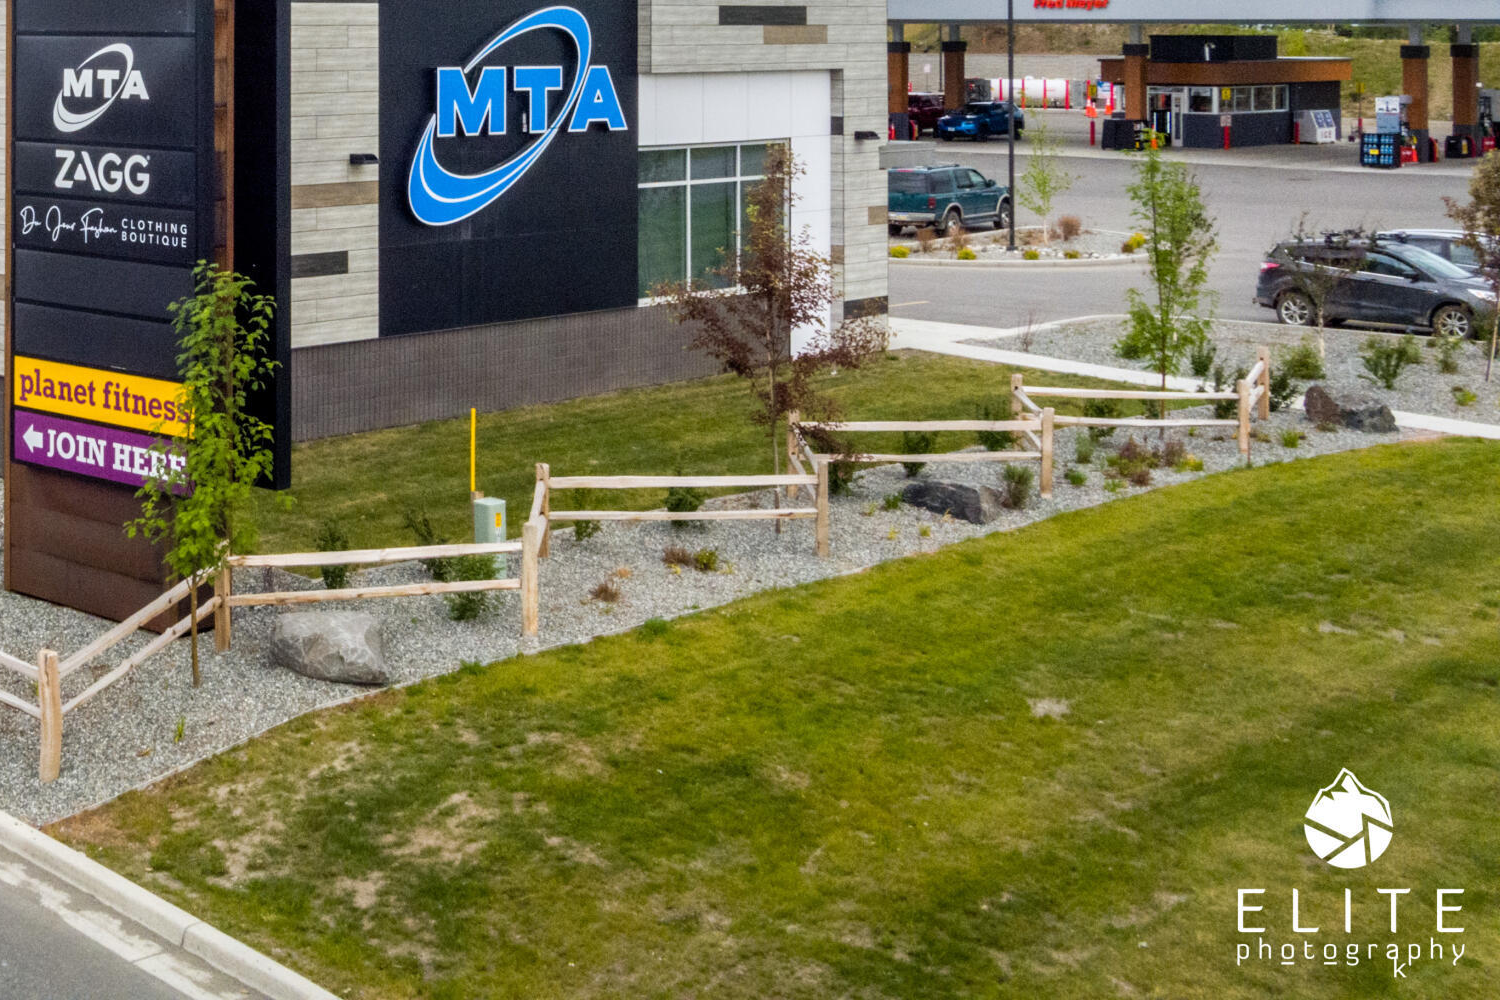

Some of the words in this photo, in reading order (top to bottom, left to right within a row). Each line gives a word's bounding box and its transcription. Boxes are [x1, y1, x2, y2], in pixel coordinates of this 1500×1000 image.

[63, 67, 150, 100] MTA
[436, 65, 629, 138] MTA
[54, 149, 151, 195] ZAGG
[121, 218, 188, 235] CLOTHING
[121, 232, 188, 248] BOUTIQUE
[19, 369, 96, 407] planet
[102, 381, 190, 424] fitness
[47, 429, 107, 468] JOIN
